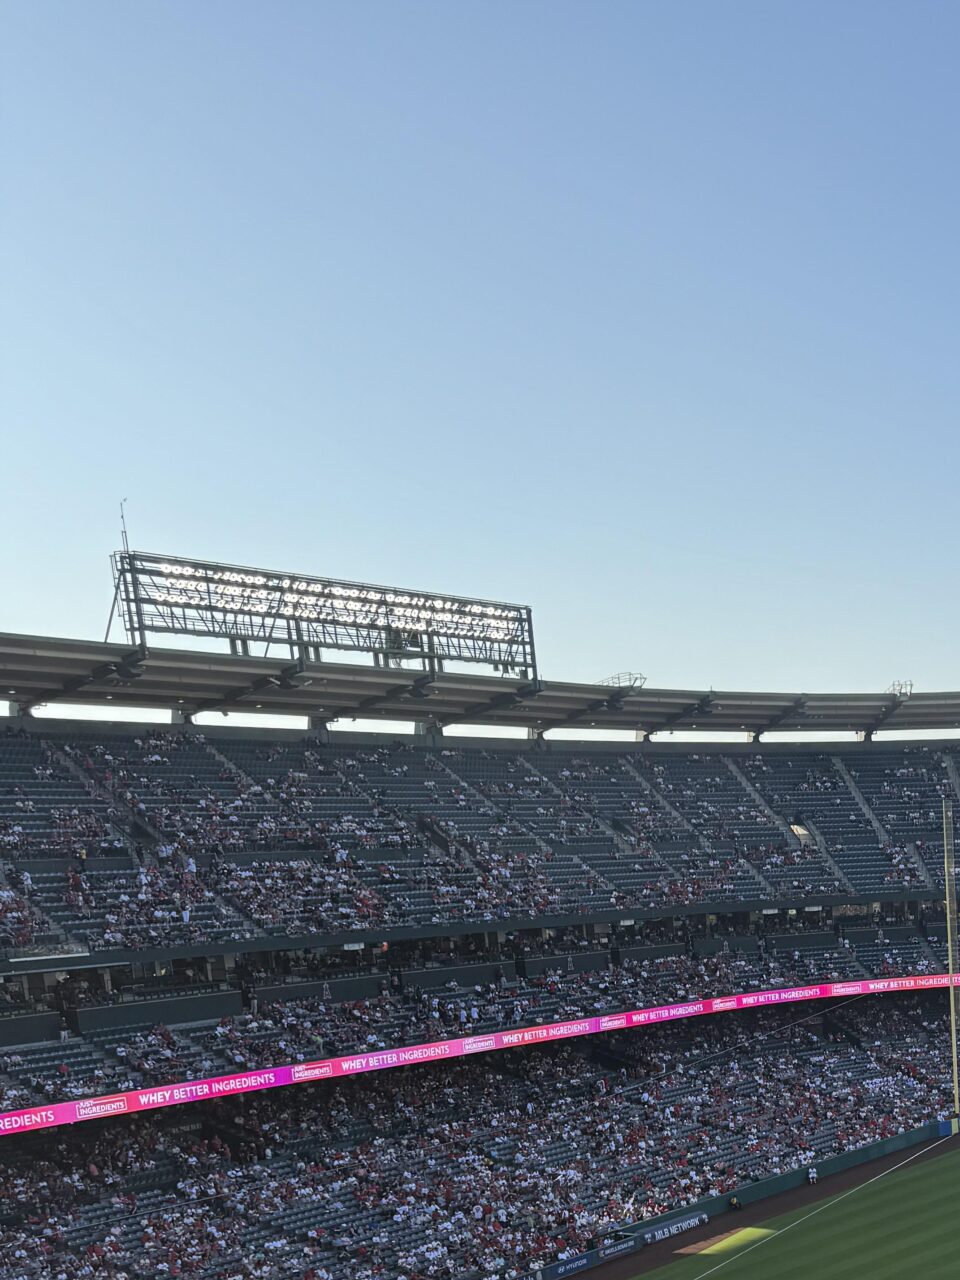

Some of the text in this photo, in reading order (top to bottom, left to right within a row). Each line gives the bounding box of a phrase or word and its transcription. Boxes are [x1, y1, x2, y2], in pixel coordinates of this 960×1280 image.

[868, 980, 915, 991] WHEY BETTER
[742, 988, 820, 1004] WHEY BETTER INGREDIENTS
[632, 1004, 703, 1022] WHEY BETTER INGREDIENTS
[502, 1024, 589, 1043] WHEY BETTER INGREDIENTS
[342, 1045, 450, 1071] WHEY BETTER INGREDIENTS
[294, 1066, 330, 1078] INGREDIENTS
[139, 1073, 275, 1105] WHEY BETTER INGREDIENTS
[80, 1103, 125, 1115] INGREDIENTS
[655, 1217, 700, 1241] MLB NETWORK
